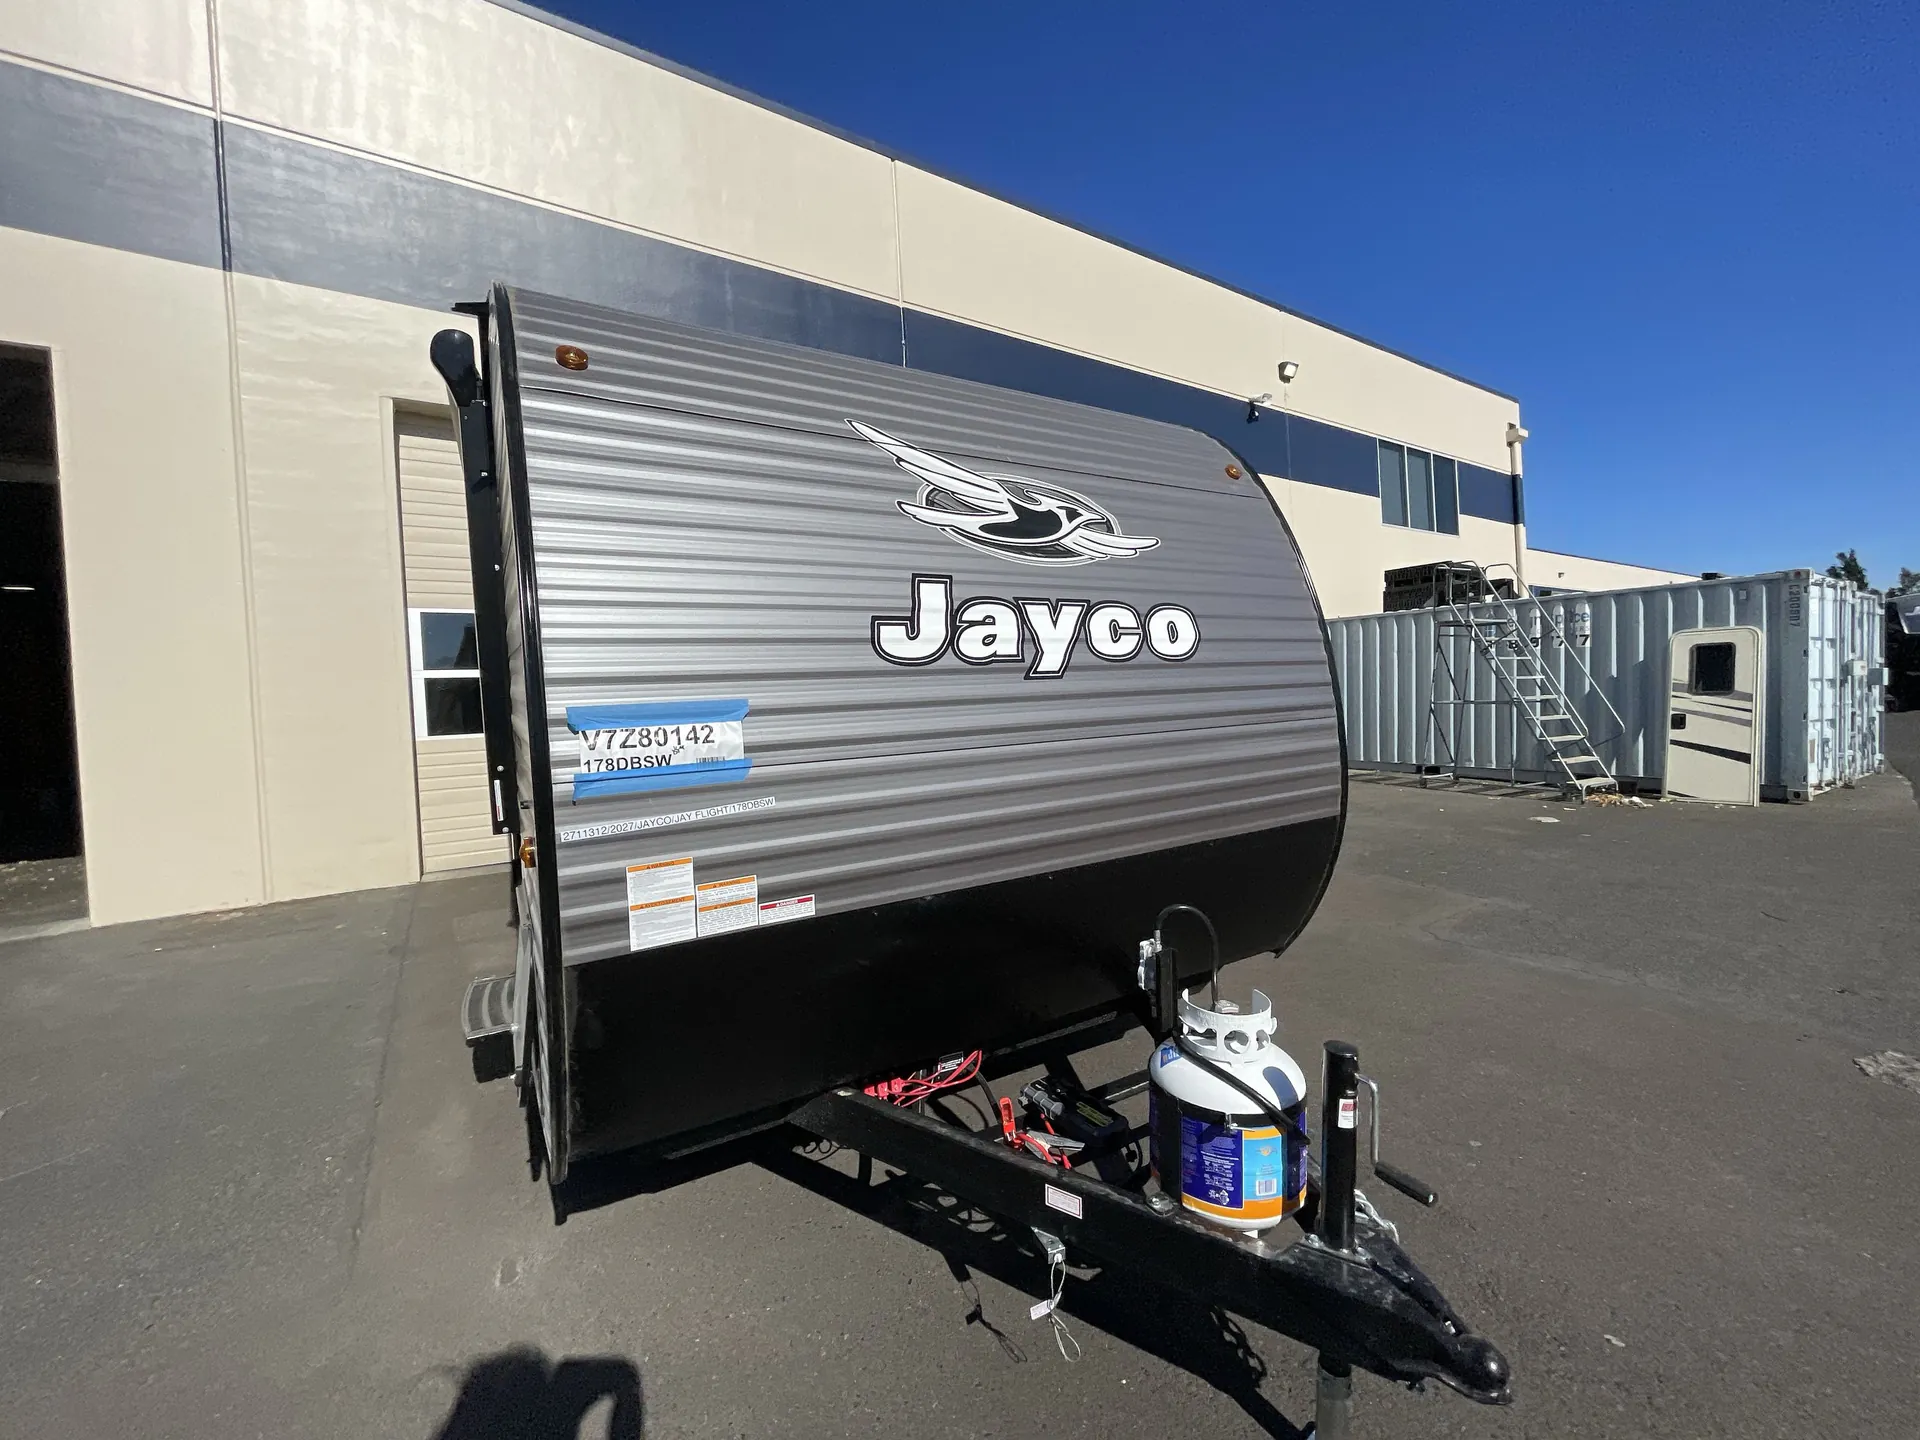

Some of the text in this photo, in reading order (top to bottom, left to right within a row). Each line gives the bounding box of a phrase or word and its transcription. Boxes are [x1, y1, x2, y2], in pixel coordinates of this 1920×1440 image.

[871, 573, 1200, 680] Jayco
[581, 725, 715, 751] V7Z80142
[583, 754, 672, 773] 178DBSW
[562, 798, 775, 841] 2711312/2027/JAYCO/JAY FLIGHT/178DBSW
